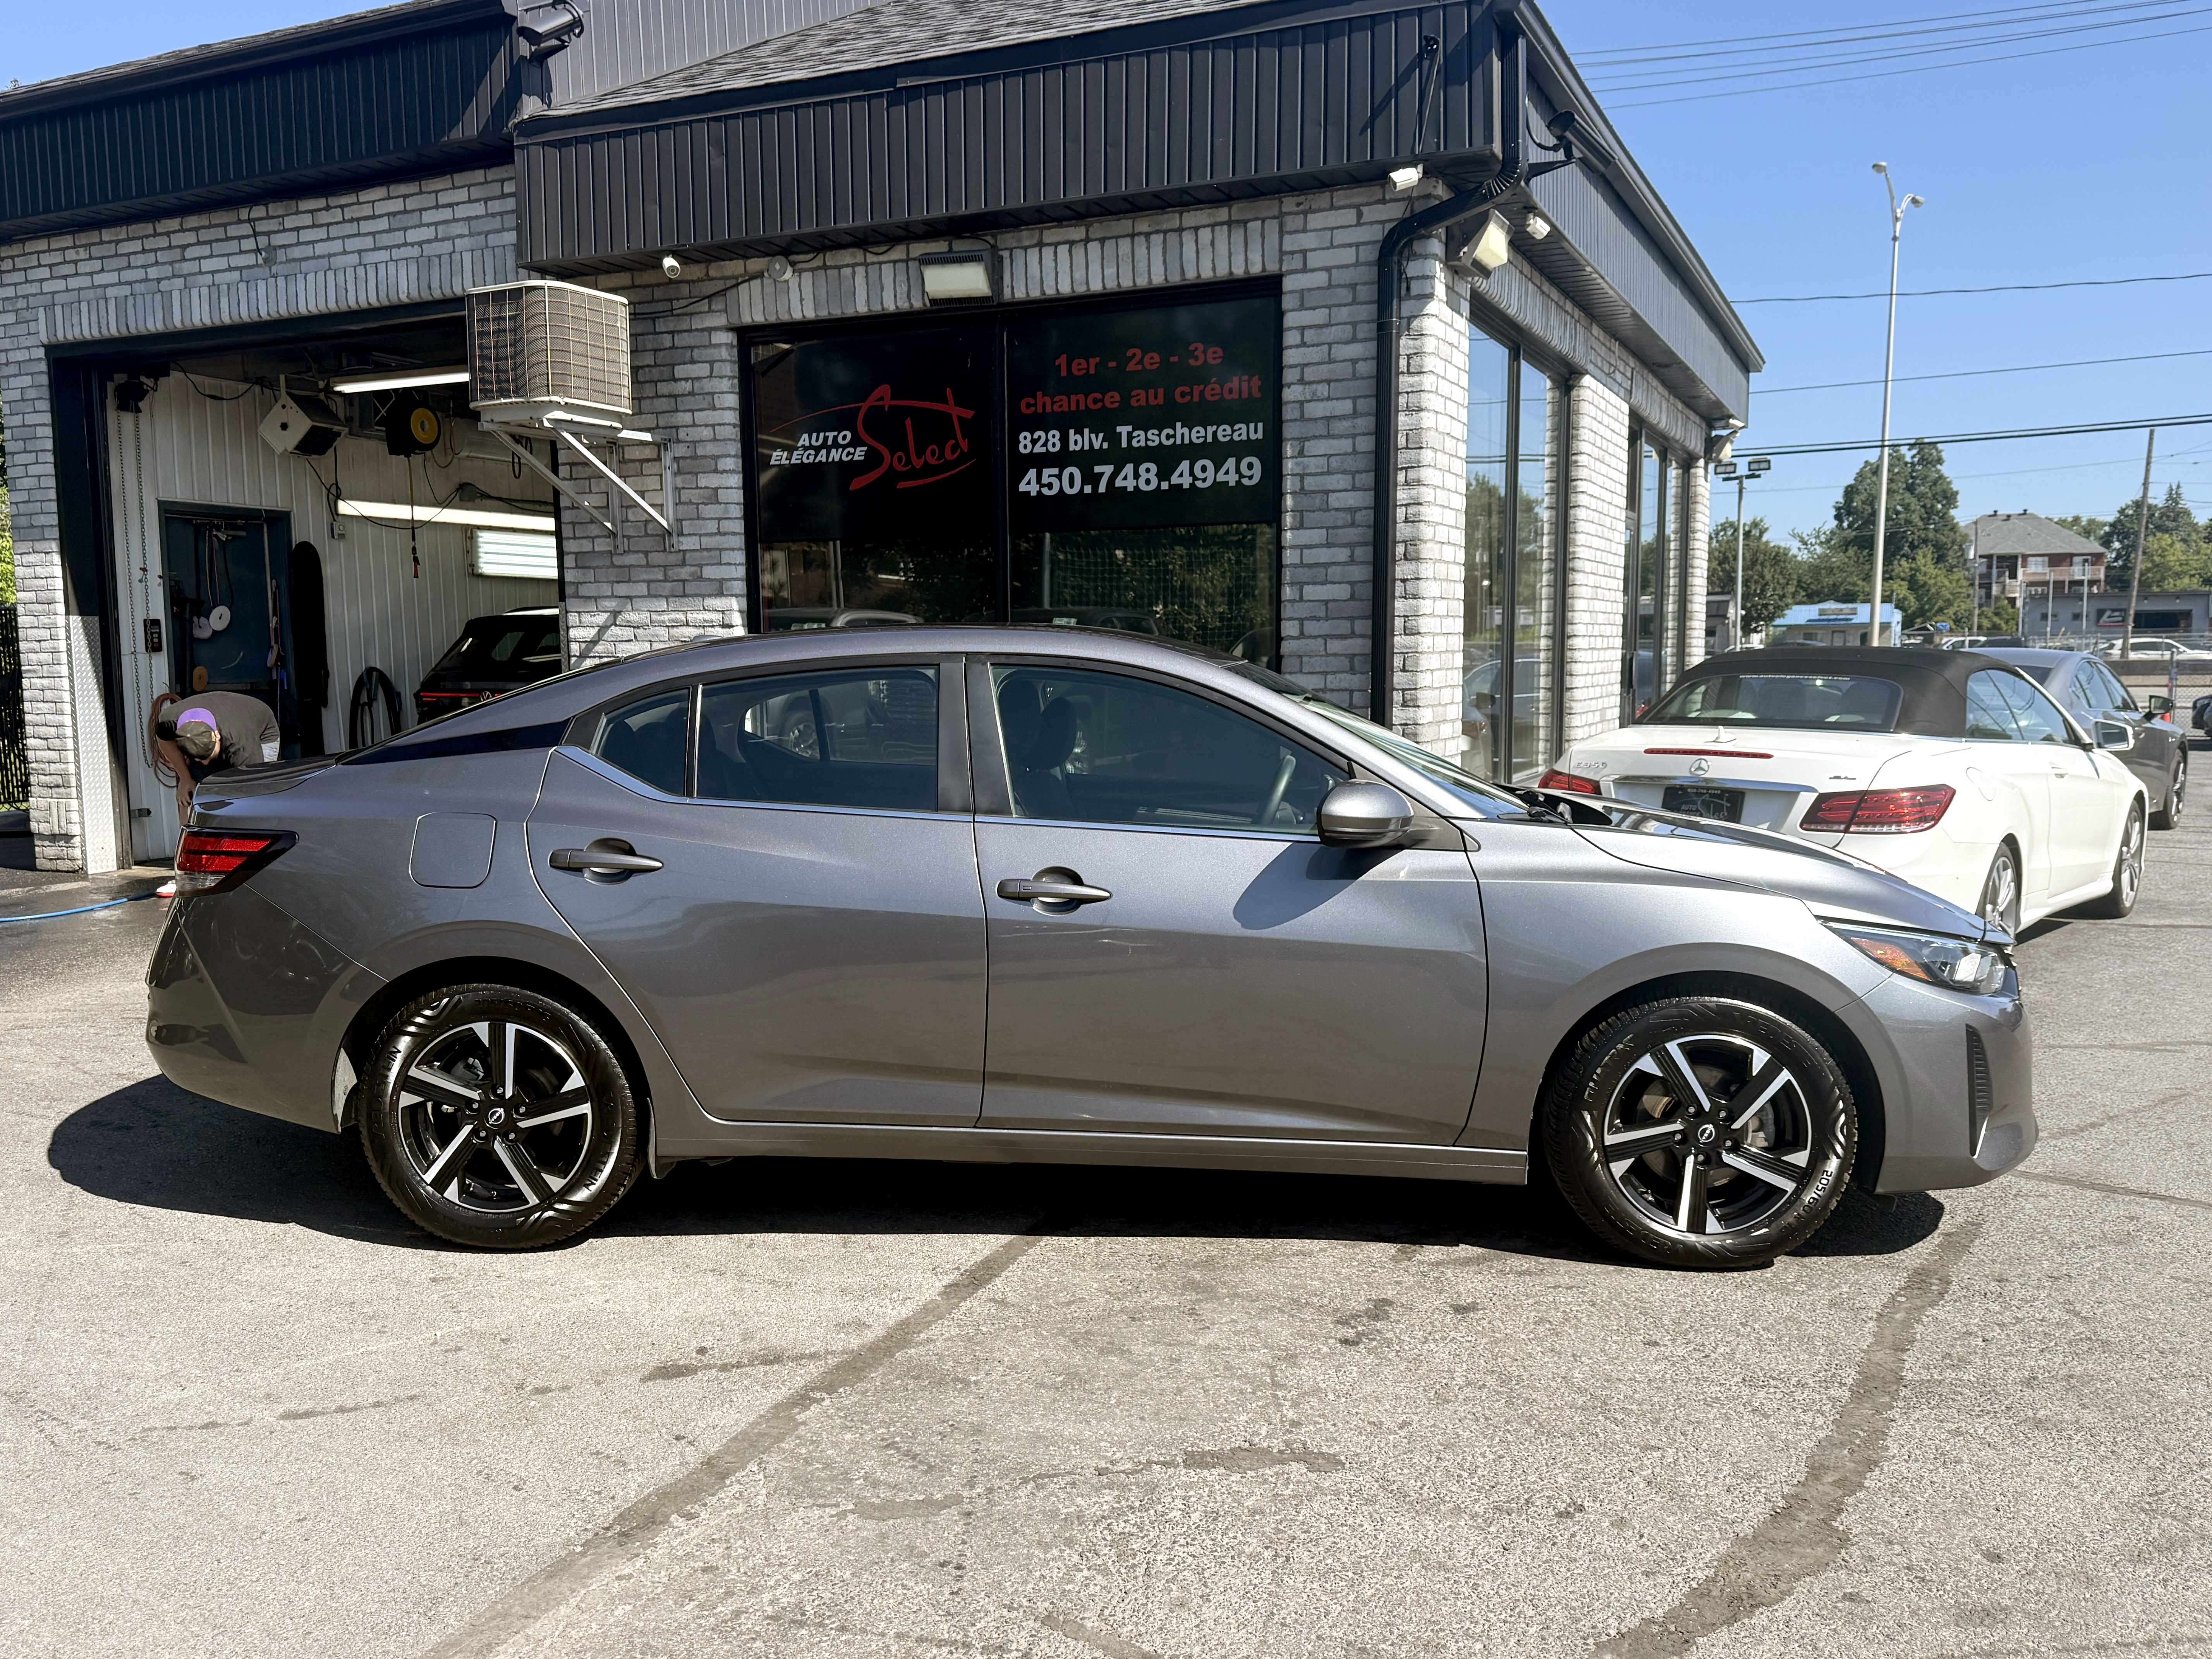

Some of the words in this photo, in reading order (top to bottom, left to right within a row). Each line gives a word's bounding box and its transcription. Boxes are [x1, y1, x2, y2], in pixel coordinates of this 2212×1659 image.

[1055, 354, 1100, 377] 1er
[1126, 348, 1160, 372] 2e
[1188, 342, 1224, 366] 3e
[1020, 391, 1121, 414] chance
[1130, 388, 1164, 407] au
[1174, 374, 1261, 403] crédit
[769, 447, 867, 465] ÉLÉGANCE
[797, 430, 852, 447] AUTO
[849, 384, 975, 491] Select
[1018, 429, 1061, 454] 828
[1069, 428, 1108, 451] blv.
[1116, 422, 1264, 448] Taschereau
[1018, 456, 1262, 496] 450.748.4949
[1802, 1170, 1834, 1214] 205/60
